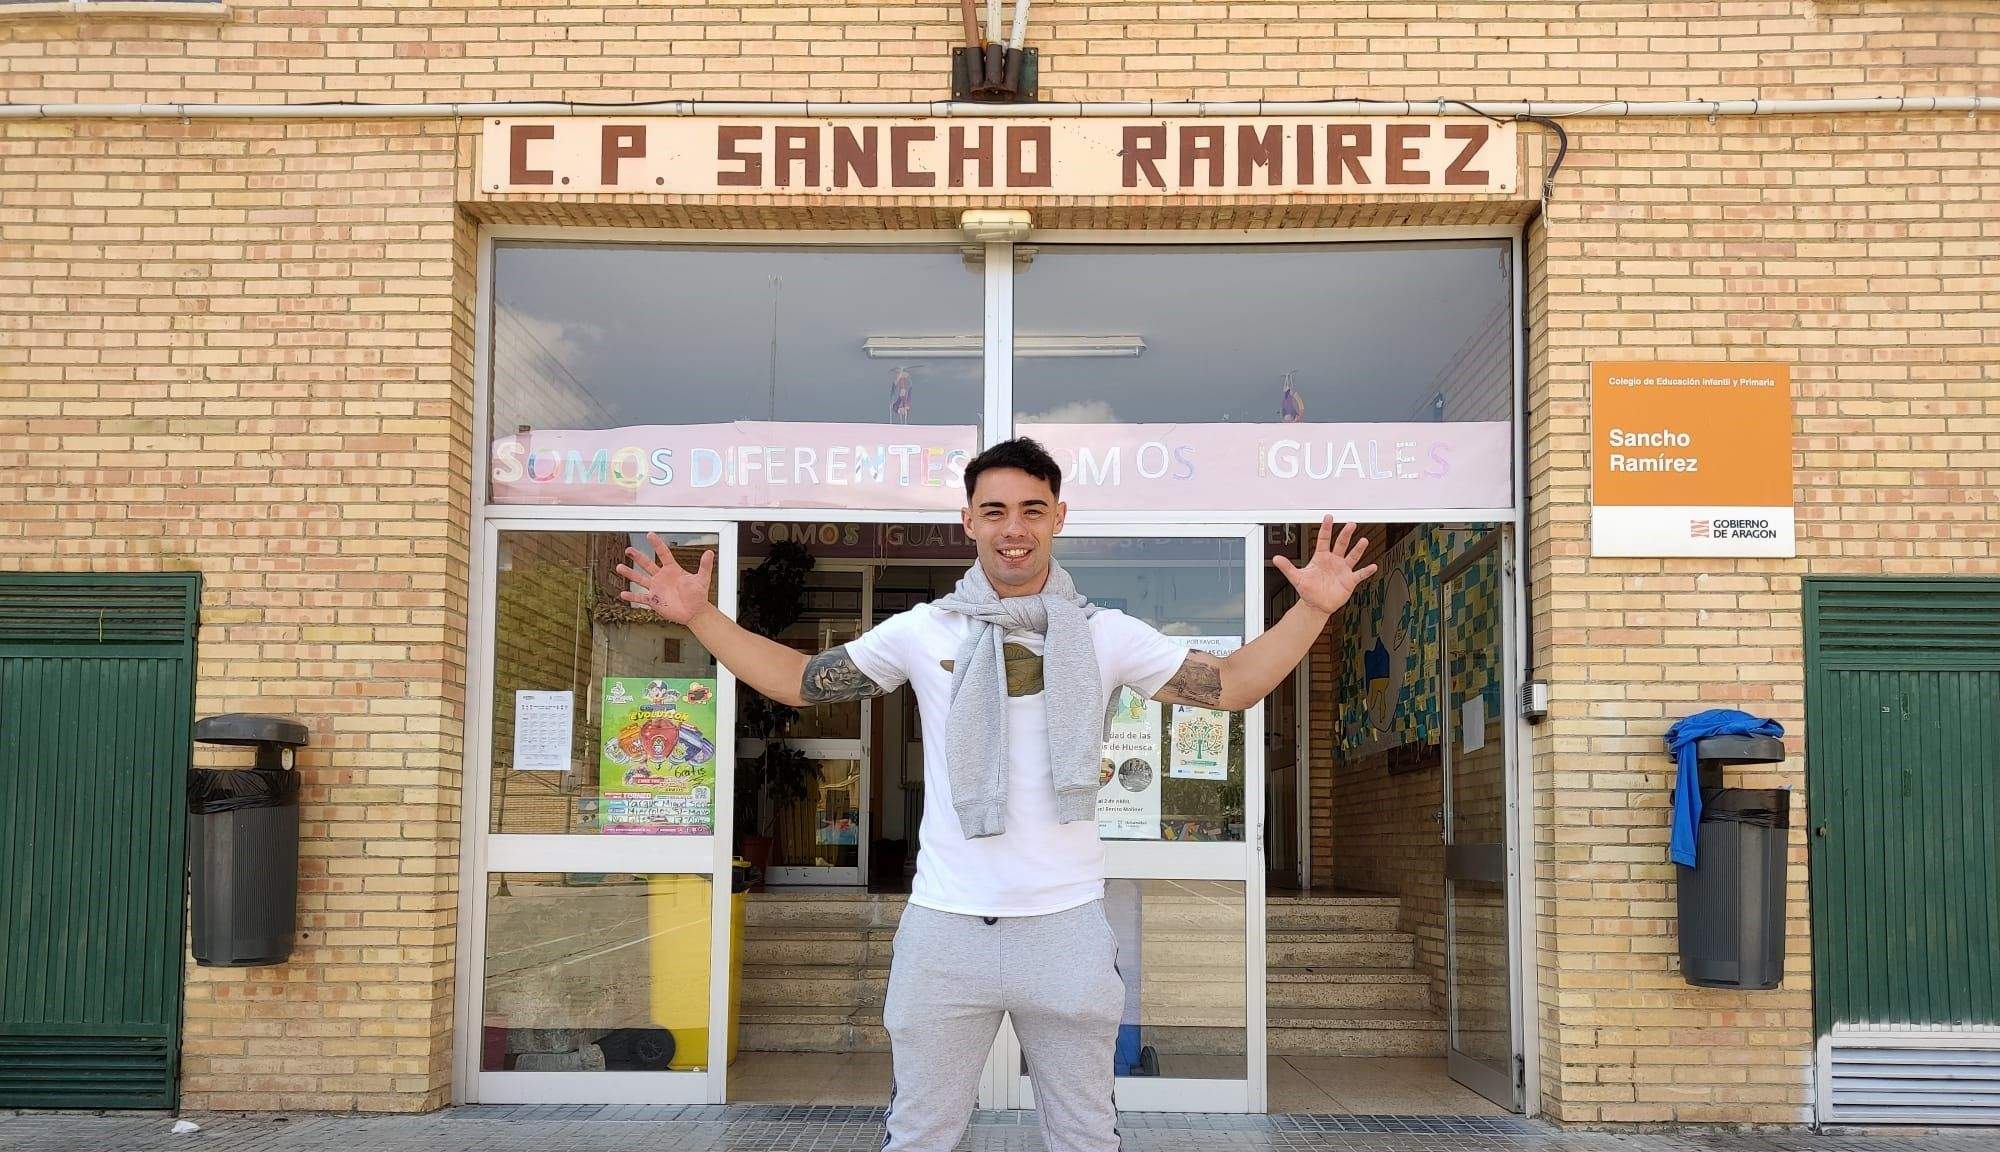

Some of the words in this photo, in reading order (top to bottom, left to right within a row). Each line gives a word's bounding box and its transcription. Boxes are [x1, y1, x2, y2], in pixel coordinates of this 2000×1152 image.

[510, 125, 571, 185] C.
[600, 124, 665, 185] P.
[716, 124, 1052, 188] SANCHO
[1124, 123, 1491, 187] RAMIREZ
[1609, 377, 1641, 387] Colegio
[1643, 377, 1654, 386] de
[1656, 377, 1700, 386] Educación
[1702, 378, 1730, 386] Infantil
[1732, 379, 1738, 388] y
[1740, 378, 1775, 387] Primaria
[1609, 428, 1691, 447] Sancho
[494, 442, 674, 489] SOMOS
[689, 444, 968, 488] DIFERENTES
[1256, 439, 1452, 480] IGUALES
[1610, 453, 1698, 472] Ramírez
[1713, 519, 1769, 529] GOBIERNO
[750, 522, 859, 546] SOMOS
[1713, 529, 1728, 538] DE
[1732, 529, 1777, 539] ARAGON
[1127, 731, 1137, 739] de
[1139, 731, 1151, 739] las
[1110, 743, 1121, 751] de
[1122, 743, 1153, 751] Huesca
